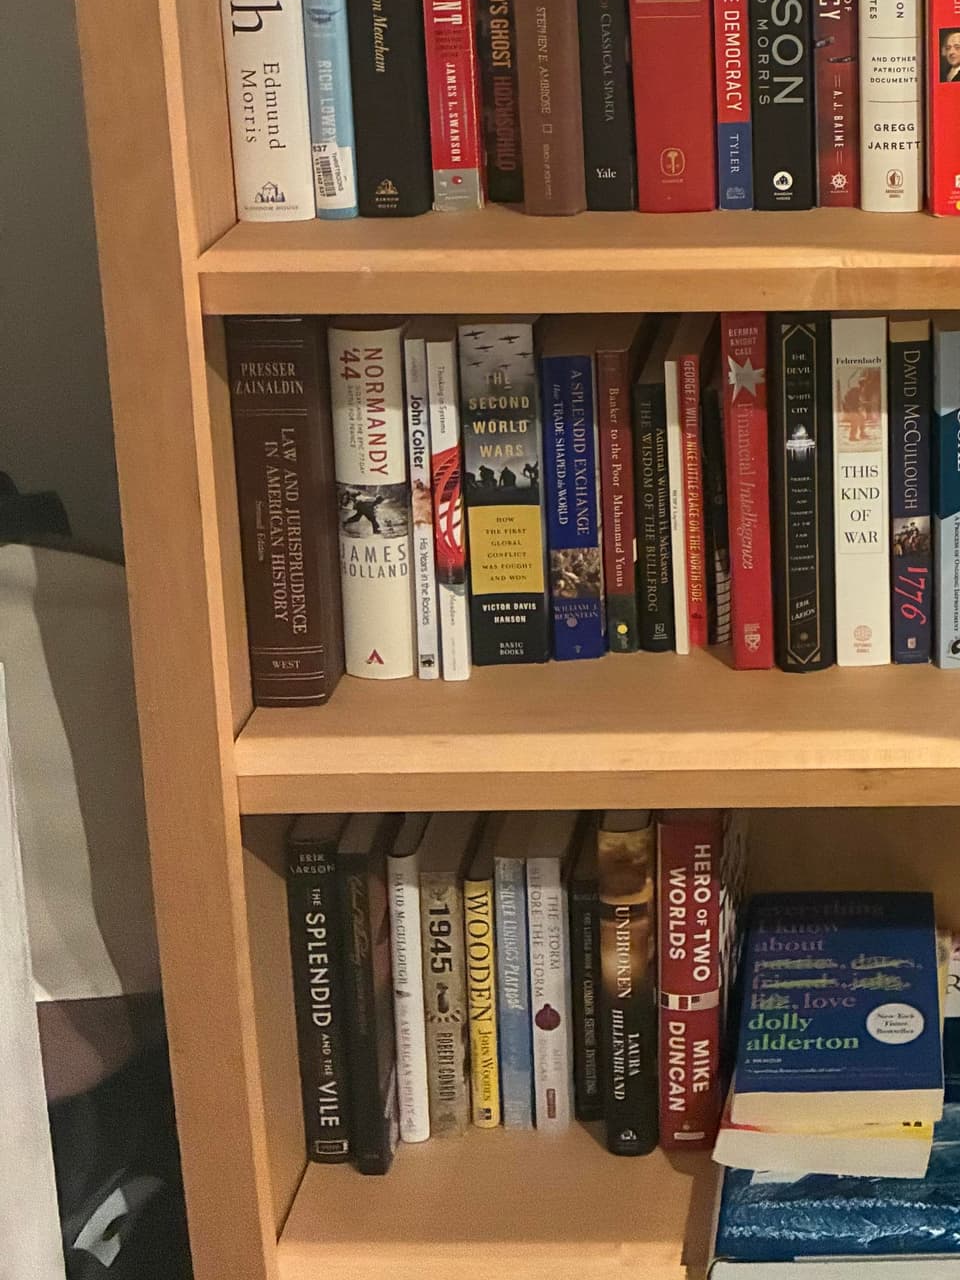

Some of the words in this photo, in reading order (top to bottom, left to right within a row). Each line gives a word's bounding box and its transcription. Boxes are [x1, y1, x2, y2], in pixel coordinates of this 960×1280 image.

[369, 20, 385, 72] Meacham
[490, 11, 512, 68] GHOST
[316, 59, 332, 93] RICH
[725, 10, 742, 111] DEMOCRACY
[757, 19, 770, 106] MORRIS
[240, 69, 257, 144] Morris
[262, 62, 286, 150] Edmund
[321, 95, 335, 144] LOWRY
[874, 123, 915, 132] GREGG
[730, 133, 739, 174] TYLER
[868, 141, 921, 150] JARRETT
[596, 168, 616, 179] Yale
[241, 362, 295, 375] PRESSER
[339, 348, 360, 381] '44
[836, 357, 882, 366] Fehrenbach
[904, 350, 920, 399] DAVID
[236, 381, 303, 395] ZAINALDIN
[469, 396, 530, 409] SECOND
[364, 347, 389, 477] NORMANDY
[410, 394, 421, 421] John
[570, 385, 586, 452] SPLENDID
[608, 388, 617, 426] Banker
[281, 427, 297, 462] LAW
[473, 421, 528, 434] WORLD
[610, 429, 618, 441] to
[264, 440, 278, 458] IN
[410, 425, 424, 470] Colter
[480, 445, 524, 458] WARS
[611, 444, 619, 460] the
[284, 467, 298, 497] AND
[612, 464, 621, 489] Poor
[841, 466, 879, 479] THIS
[266, 465, 284, 545] AMERICAN
[573, 457, 590, 536] EXCHANGE
[840, 487, 880, 500] KIND
[850, 509, 871, 522] OF
[844, 531, 878, 544] WAR
[286, 502, 307, 635] JURISPRUDENCE
[272, 549, 289, 623] HISTORY
[894, 566, 928, 625] 1776
[483, 603, 512, 612] VICTOR
[513, 602, 537, 611] DAVIS
[494, 616, 526, 624] HANSON
[693, 844, 711, 905] HERO
[311, 888, 321, 905] THE
[669, 868, 686, 961] WORLDS
[697, 908, 708, 923] OF
[428, 905, 452, 973] 1945
[613, 906, 632, 1000] UNBROKEN
[692, 927, 710, 982] TWO
[754, 937, 824, 952] about
[305, 913, 334, 1027] SPLENDID
[468, 891, 492, 1022] WOODEN
[803, 993, 856, 1008] love
[748, 1014, 813, 1032] dolly
[321, 1033, 330, 1056] AND
[612, 1009, 627, 1102] HILLENBRAND
[628, 1032, 640, 1077] LAURA
[746, 1034, 858, 1051] alderton
[325, 1059, 333, 1075] THE
[668, 1021, 686, 1112] DUNCAN
[692, 1040, 710, 1093] MIKE
[317, 1081, 339, 1127] VILE
